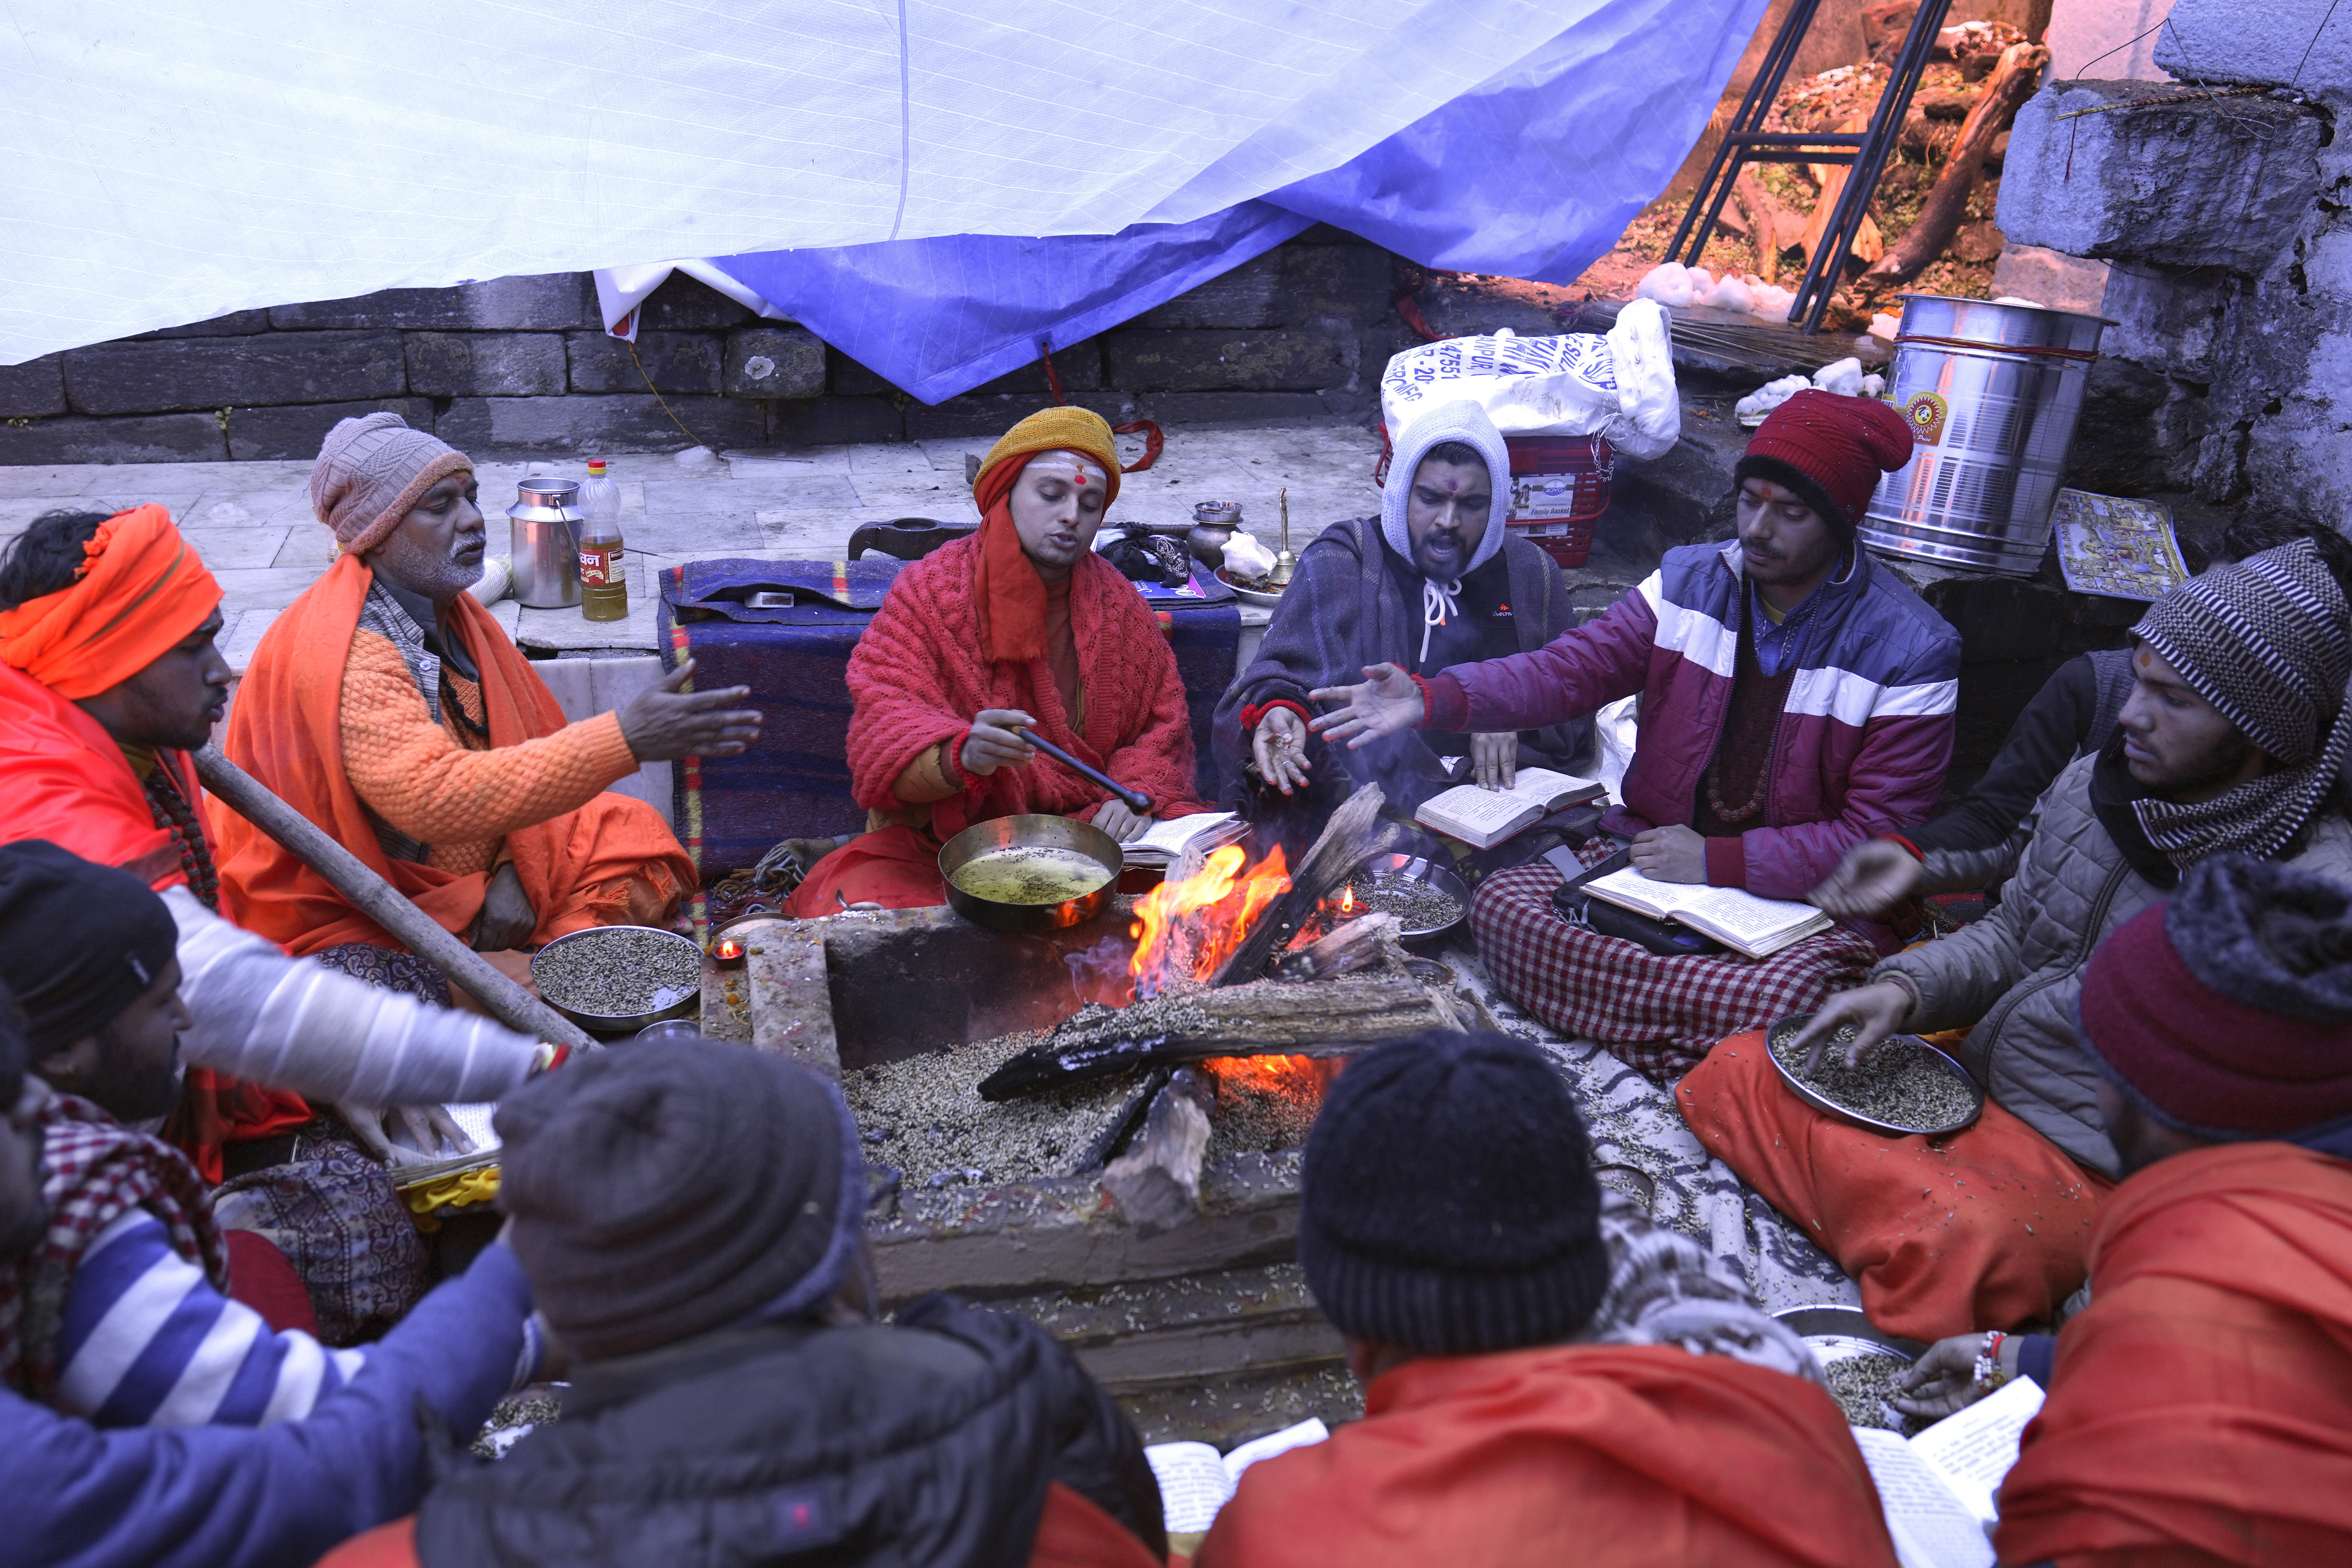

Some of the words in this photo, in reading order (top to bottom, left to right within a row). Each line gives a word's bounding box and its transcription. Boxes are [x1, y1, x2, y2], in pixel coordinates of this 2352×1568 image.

[1439, 342, 1464, 379] 247551
[1911, 416, 1920, 428] EXPORT
[1920, 419, 1934, 428] QUALITY
